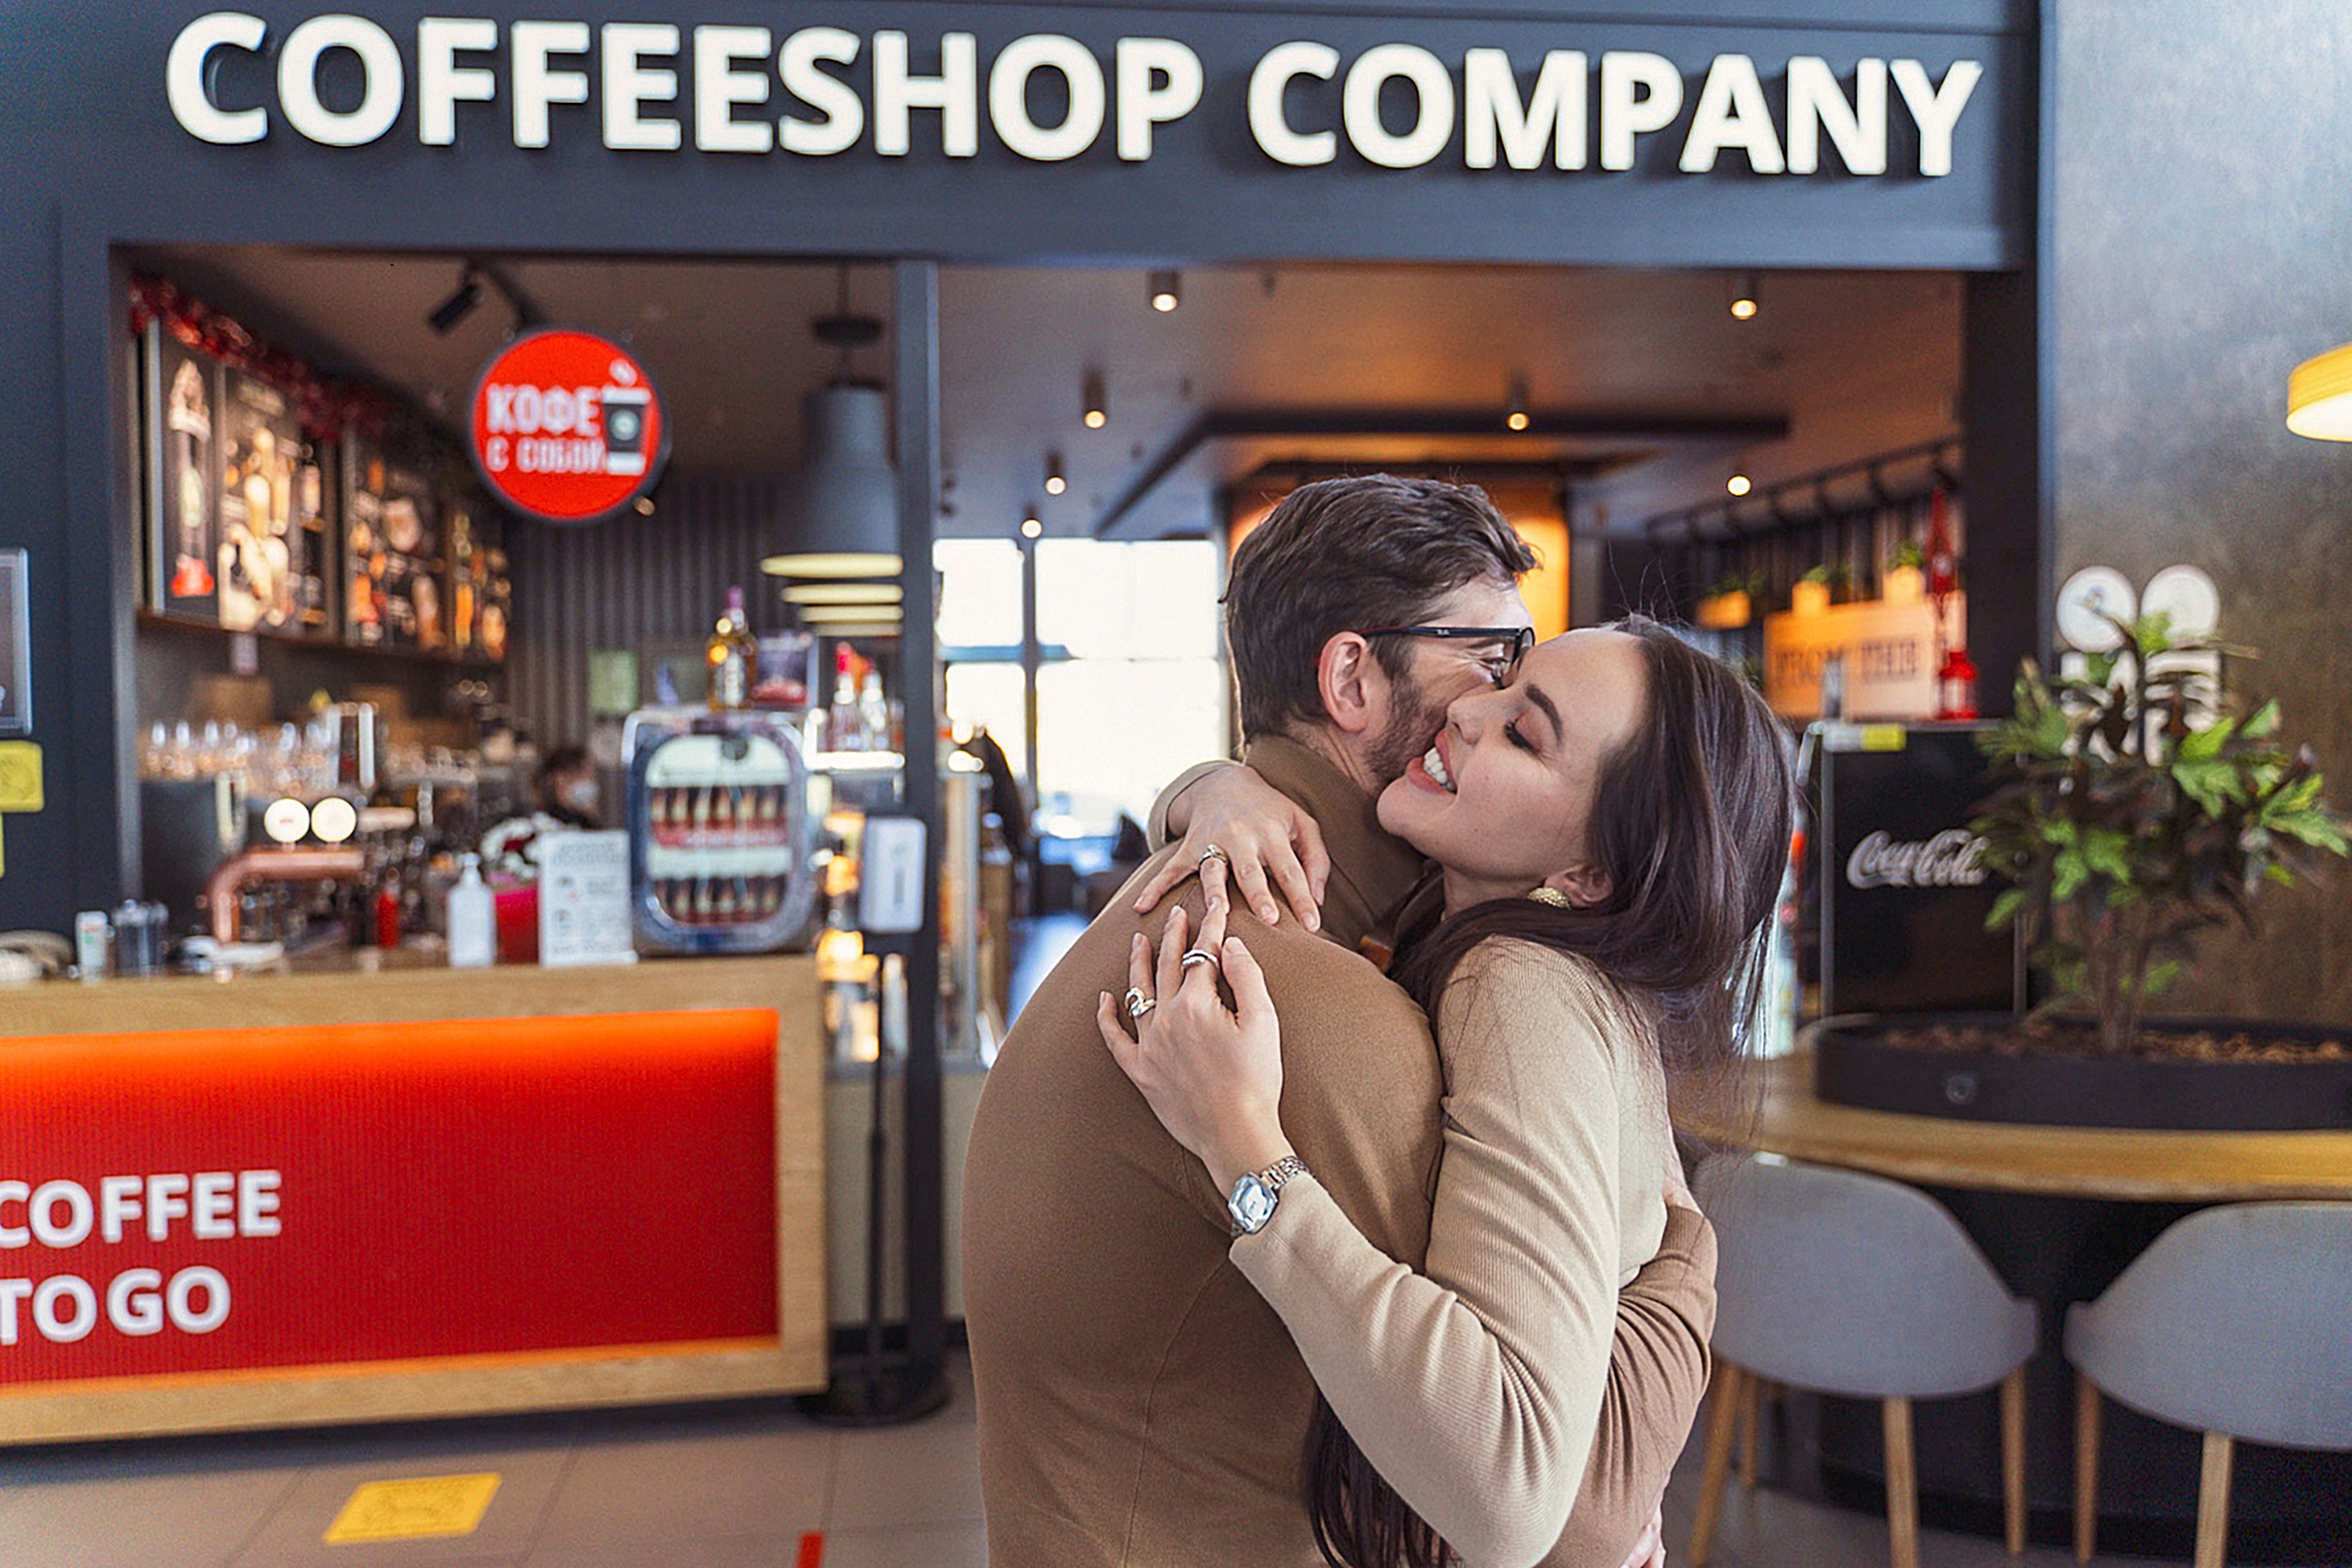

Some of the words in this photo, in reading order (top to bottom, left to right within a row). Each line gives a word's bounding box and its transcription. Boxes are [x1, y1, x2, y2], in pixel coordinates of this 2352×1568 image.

[166, 12, 1204, 163] COFFEESHOP
[1248, 40, 1984, 178] COMPANY
[486, 383, 600, 436] КОФЕ
[0, 1169, 282, 1248] COFFEE
[0, 1274, 97, 1346] TO
[106, 1265, 232, 1336] GO
